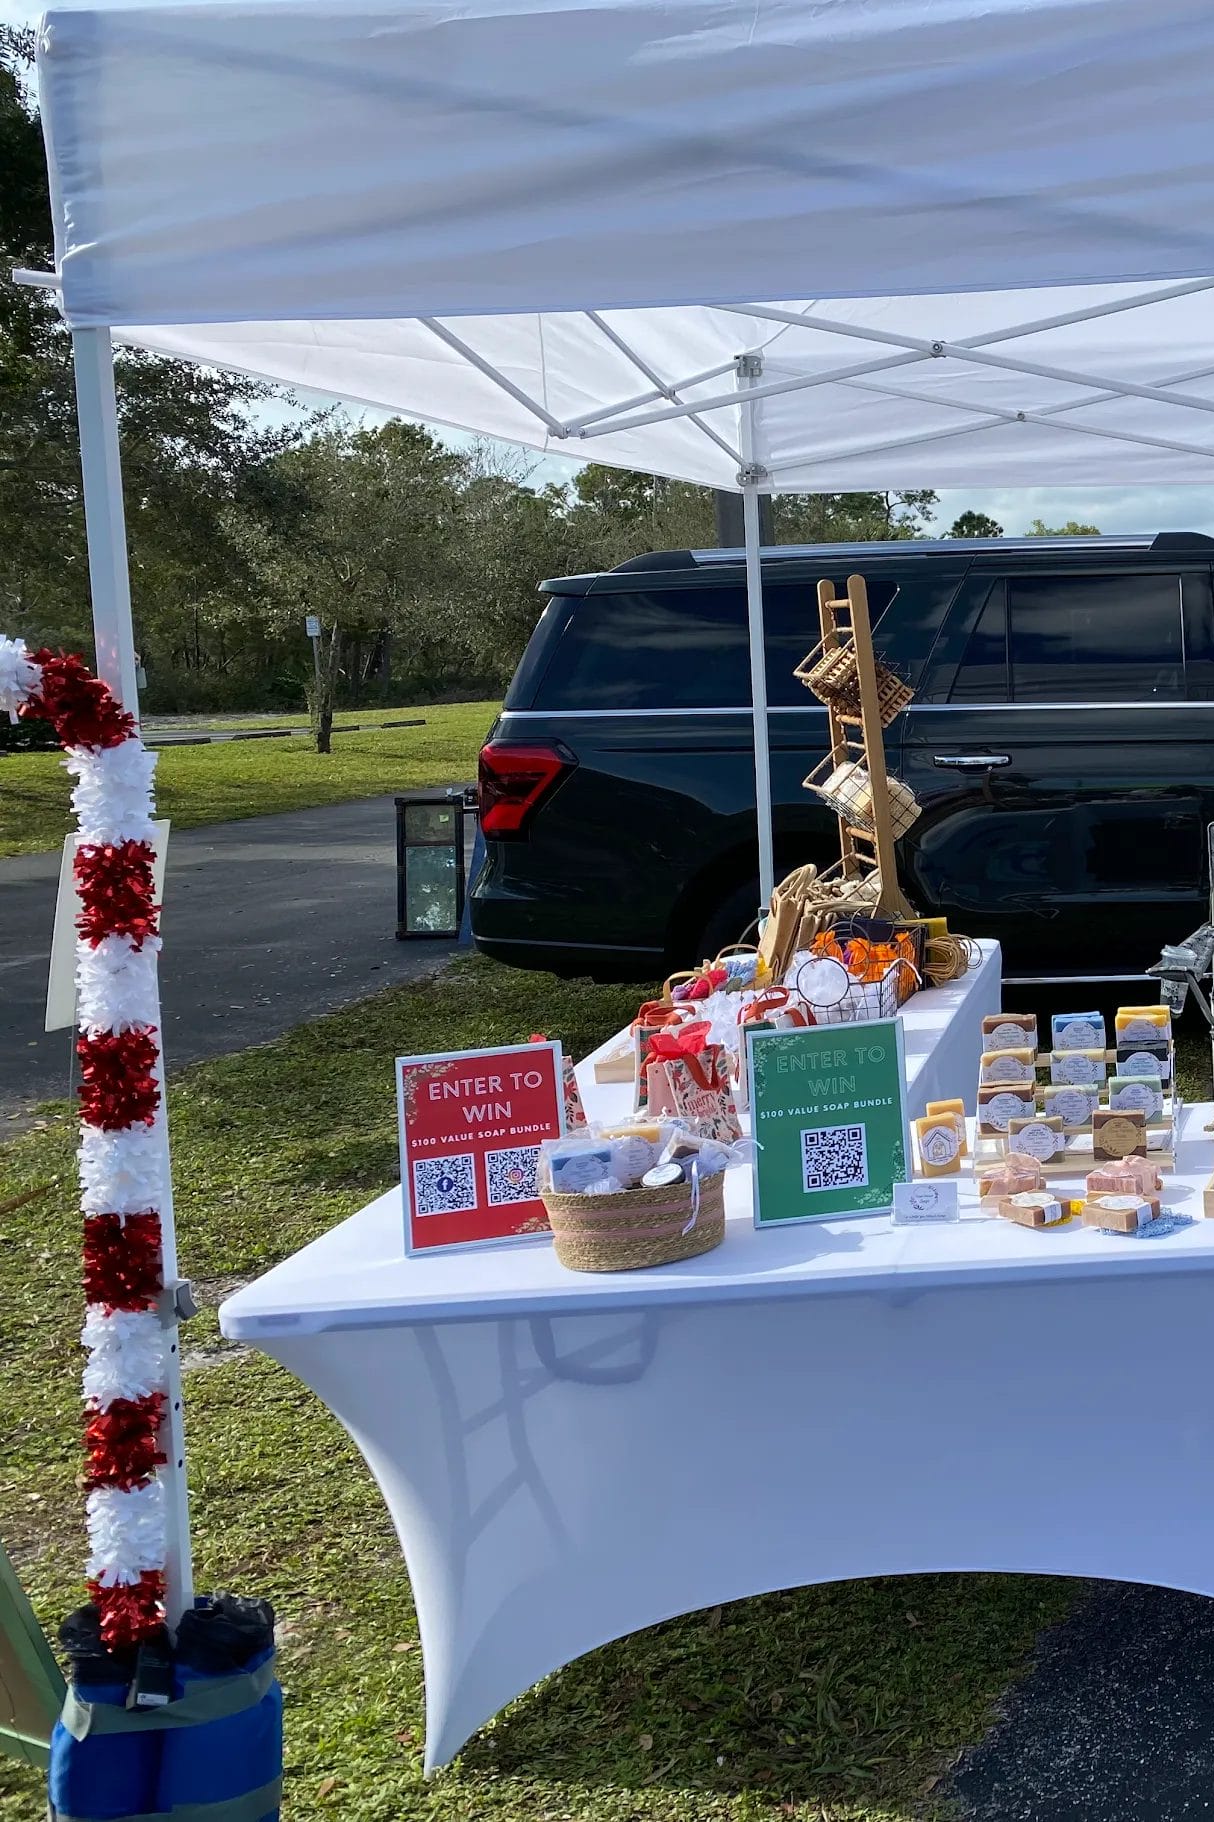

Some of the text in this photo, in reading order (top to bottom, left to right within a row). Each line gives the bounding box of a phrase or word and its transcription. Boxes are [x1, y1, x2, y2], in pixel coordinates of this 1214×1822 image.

[776, 1046, 886, 1073] ENTER TO
[428, 1070, 543, 1101] ENTER TO
[808, 1075, 856, 1097] WIN
[462, 1101, 512, 1123] WIN
[760, 1097, 893, 1119] $100 VALUE SOAP BUNDLE
[411, 1122, 551, 1148] $100 VALUE SOAP BUNDLE
